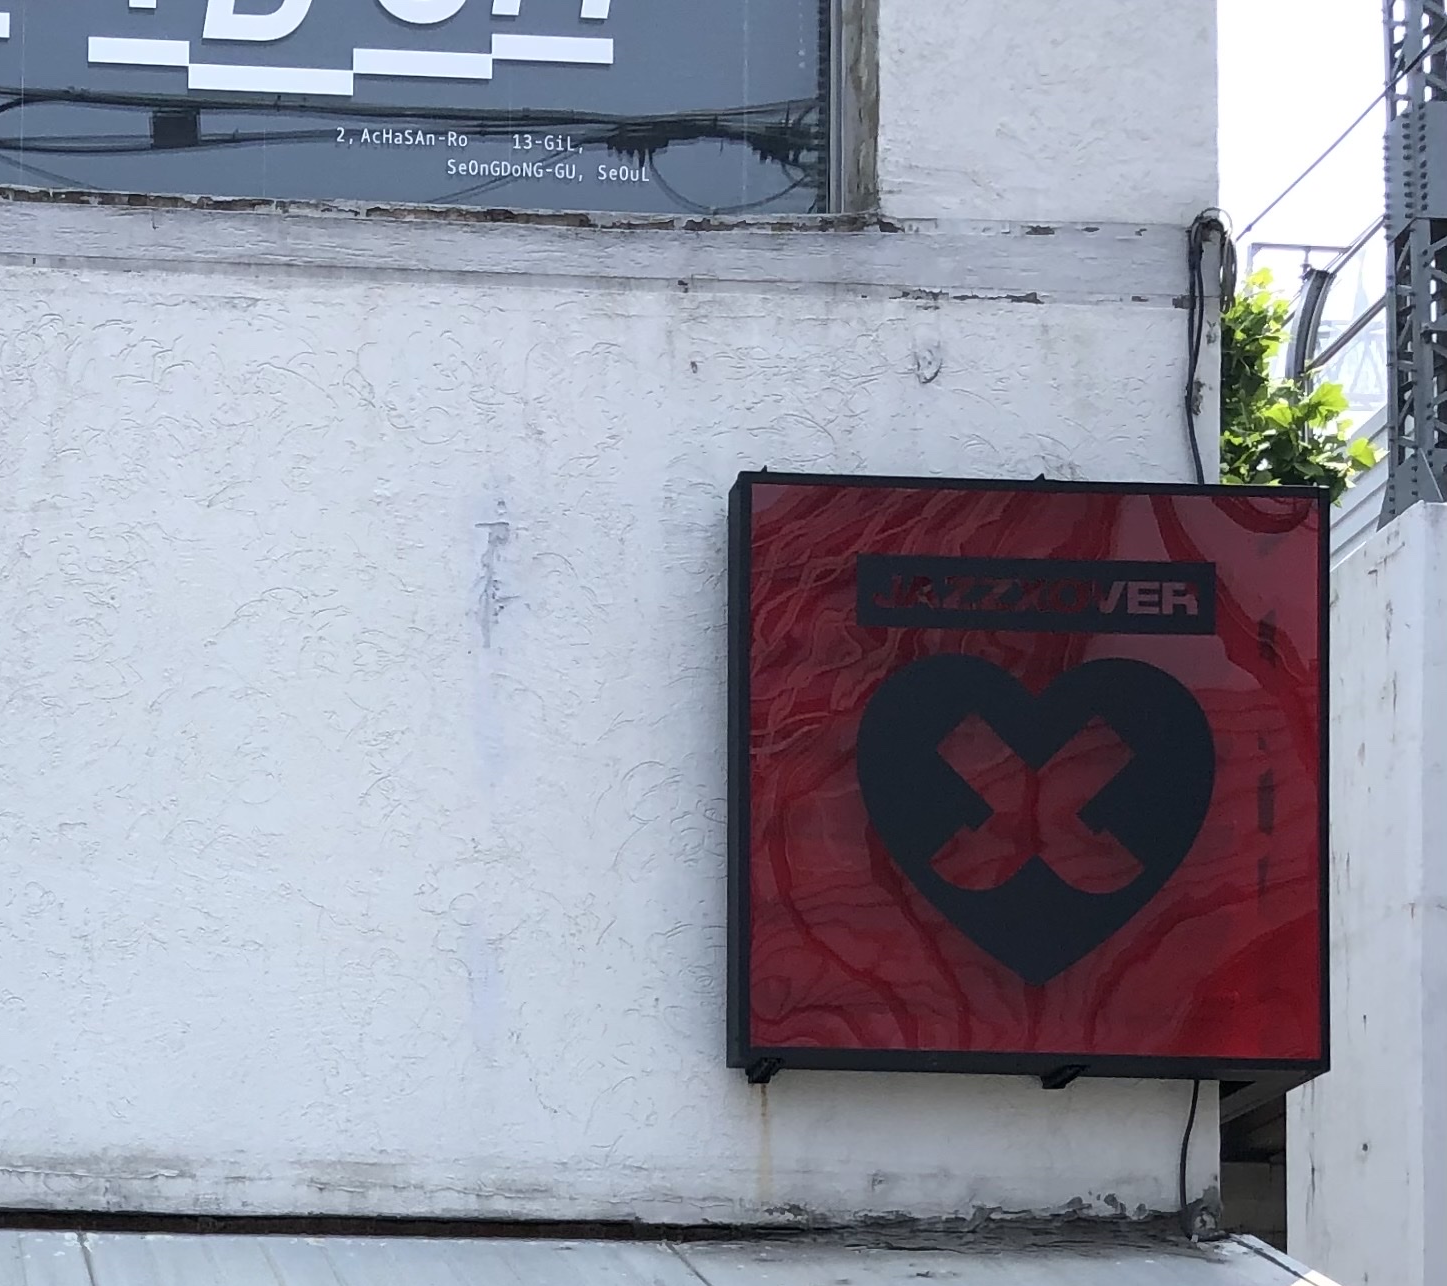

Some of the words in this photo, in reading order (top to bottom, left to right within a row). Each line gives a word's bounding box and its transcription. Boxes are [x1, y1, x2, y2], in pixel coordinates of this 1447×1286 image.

[361, 127, 468, 147] AcHaSAn-Ro
[512, 134, 584, 154] 13-GiL,
[447, 159, 585, 182] SeOnGDoNG-GU,
[598, 164, 650, 182] SeOuL
[872, 574, 1199, 615] JAZZXOVER
